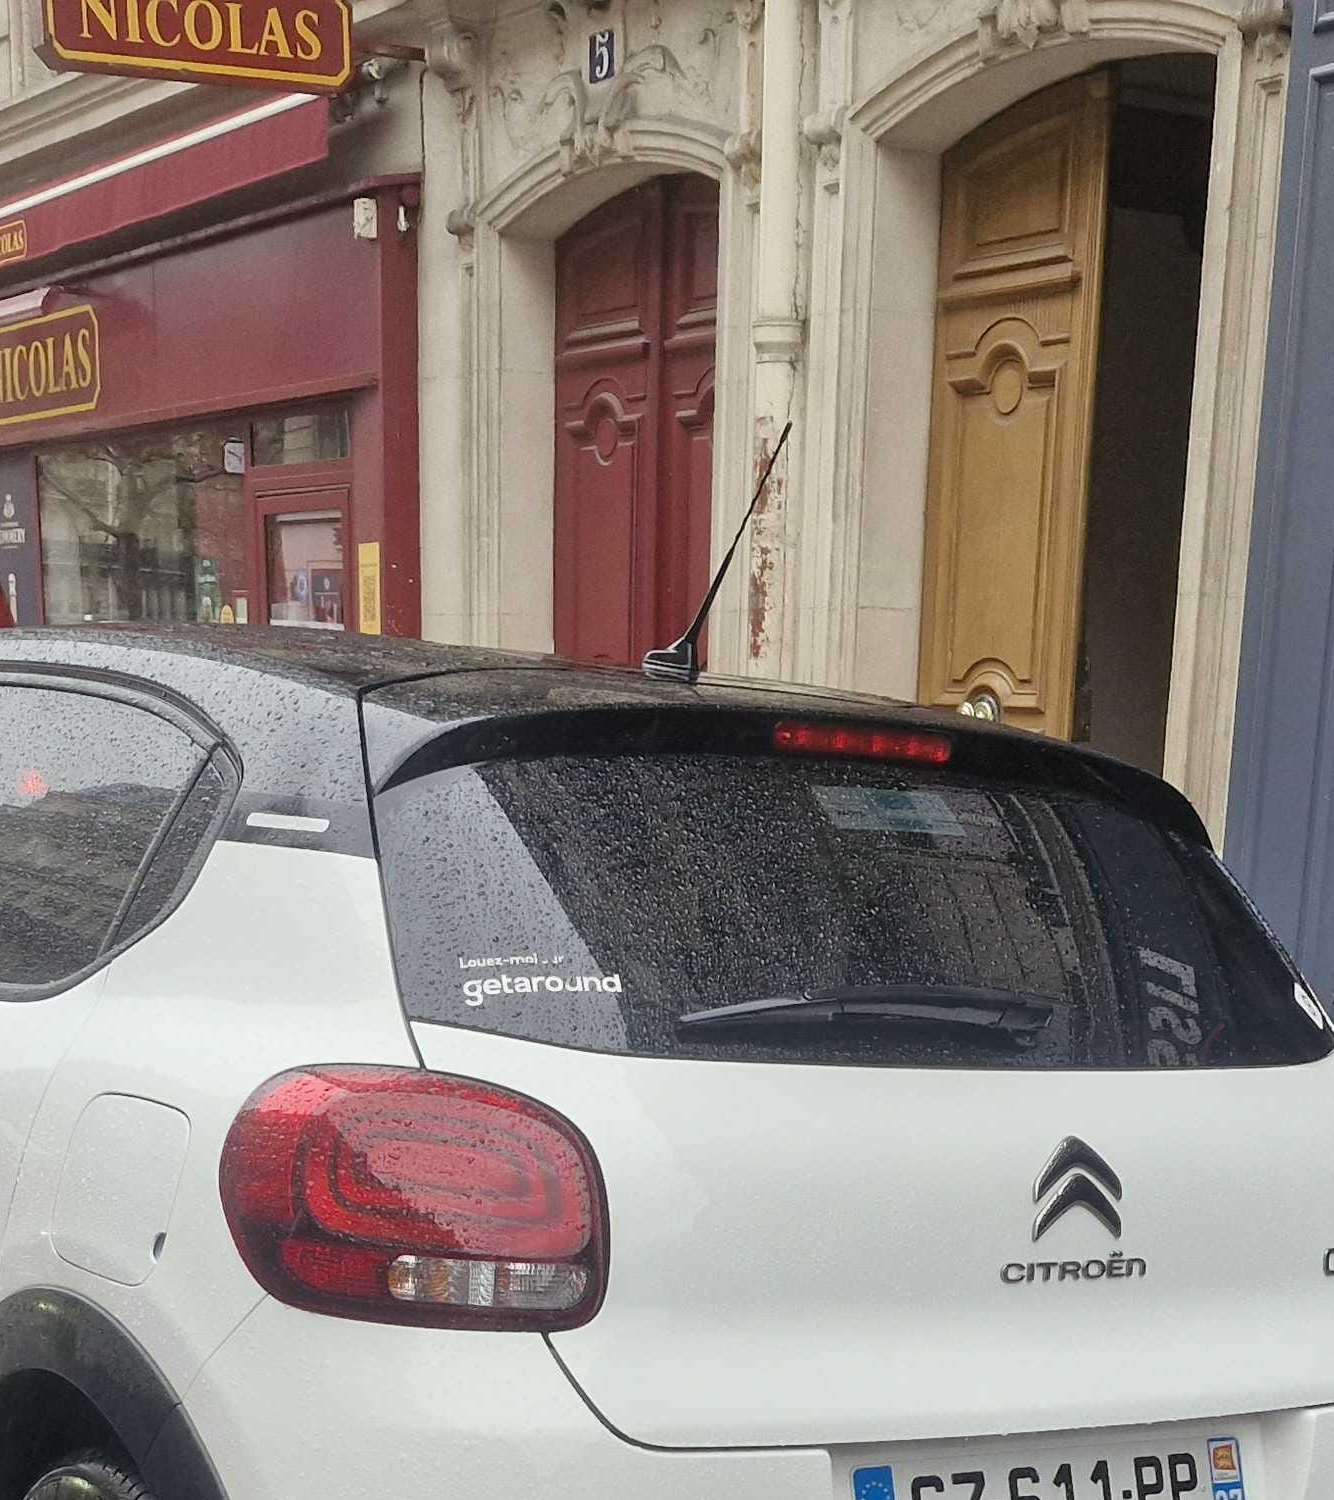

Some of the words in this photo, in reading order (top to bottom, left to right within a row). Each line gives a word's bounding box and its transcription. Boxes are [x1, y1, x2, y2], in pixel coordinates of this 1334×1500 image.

[79, 0, 321, 61] NICOLAS
[595, 32, 609, 79] 5
[463, 973, 623, 1007] getaround
